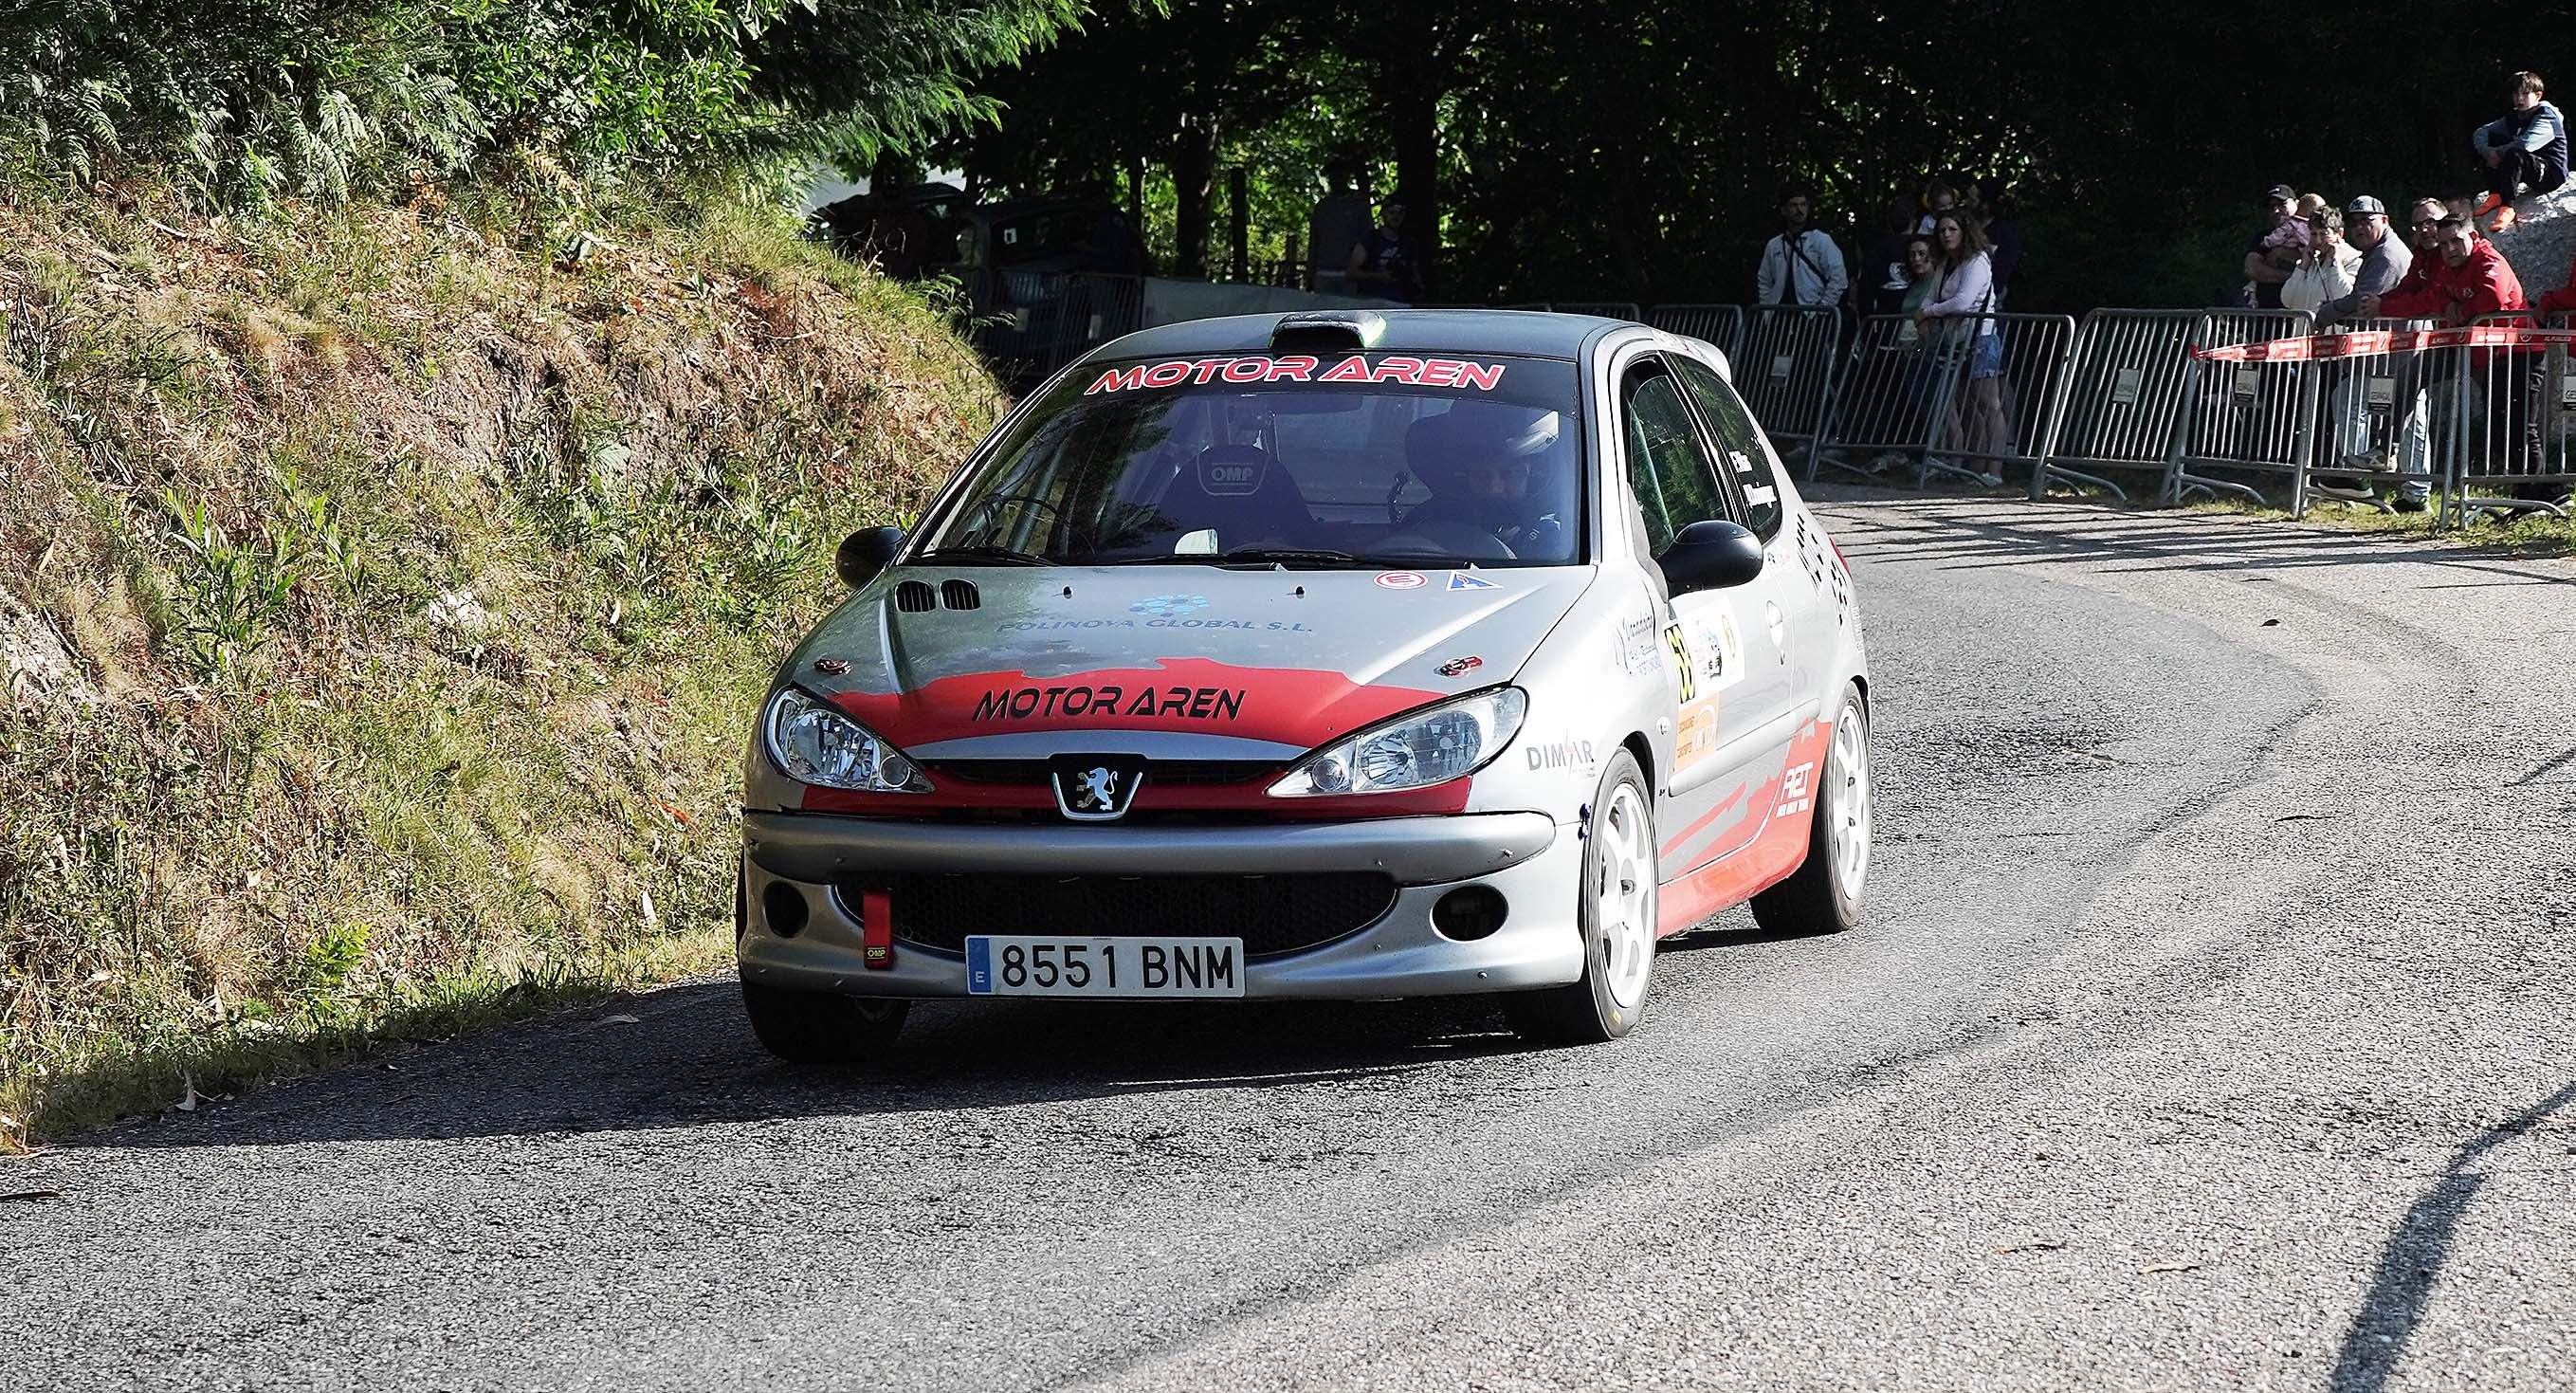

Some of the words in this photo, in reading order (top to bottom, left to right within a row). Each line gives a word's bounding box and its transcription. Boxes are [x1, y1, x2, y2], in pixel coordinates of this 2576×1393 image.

[1084, 355, 1319, 395] MOTOR
[1317, 355, 1506, 391] AREN
[1212, 467, 1252, 482] OMP
[1267, 621, 1312, 632] S.L.
[972, 687, 1122, 722] MOTOR
[1125, 687, 1246, 721] AREN
[867, 949, 886, 958] OMP
[1001, 944, 1118, 989] 8551
[1142, 945, 1234, 990] BNM
[976, 971, 985, 983] E
